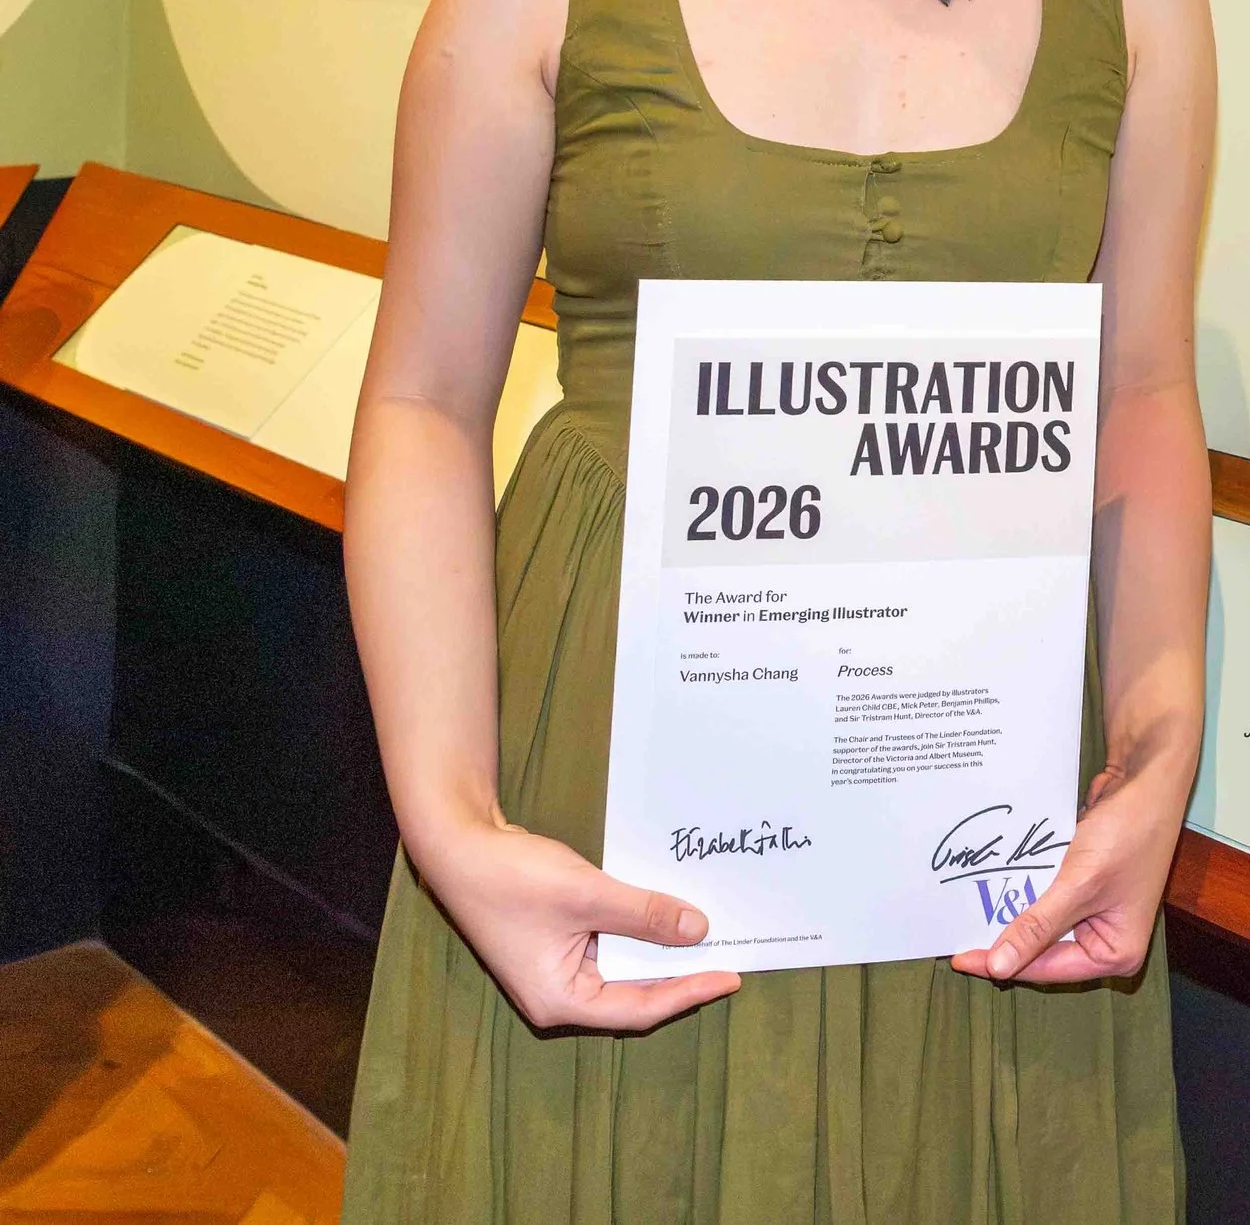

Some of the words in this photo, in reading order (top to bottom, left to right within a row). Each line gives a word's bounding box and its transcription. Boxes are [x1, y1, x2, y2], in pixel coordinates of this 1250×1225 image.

[696, 360, 1074, 416] ILLUSTRATION
[849, 419, 1071, 476] AWARDS
[687, 484, 821, 541] 2026
[684, 592, 713, 605] The
[715, 591, 762, 604] Award
[765, 590, 787, 603] for
[683, 610, 740, 624] Winner
[743, 610, 755, 622] in
[759, 607, 830, 623] Emerging
[832, 606, 908, 620] Illustrator
[838, 647, 852, 655] for:
[680, 669, 749, 684] Vannysha
[752, 667, 799, 682] Chang
[837, 665, 894, 678] Process
[836, 694, 850, 702] The
[871, 693, 898, 701] Awards
[916, 690, 941, 700] judged
[941, 690, 951, 699] by
[951, 688, 989, 696] illustrators
[835, 705, 861, 713] Lauren
[861, 704, 881, 712] Child
[881, 703, 900, 711] CBE,
[900, 702, 918, 710] Mick
[941, 699, 973, 709] Benjamin
[834, 715, 849, 723] and
[849, 714, 861, 722] Sir
[861, 714, 893, 722] Tristram
[914, 711, 945, 720] Director
[945, 710, 955, 718] of
[965, 708, 983, 717] V&A.
[834, 736, 848, 744] The
[848, 735, 868, 743] Chair
[869, 735, 883, 743] and
[884, 734, 915, 742] Trustees
[924, 732, 939, 740] The
[939, 731, 962, 739] Linder
[832, 746, 870, 755] supporter
[870, 745, 880, 753] of
[879, 745, 891, 753] the
[920, 743, 934, 751] join
[934, 742, 946, 750] Sir
[946, 740, 977, 749] Tristram
[832, 757, 864, 765] Director
[863, 756, 873, 764] of
[872, 755, 885, 763] the
[885, 754, 914, 762] Victoria
[914, 753, 928, 761] and
[928, 752, 951, 760] Albert
[839, 766, 892, 776] congratulating
[892, 765, 906, 774] you
[915, 764, 933, 773] your
[933, 762, 962, 770] success
[970, 760, 984, 768] this
[732, 938, 752, 946] Linder
[753, 936, 787, 945] Foundation
